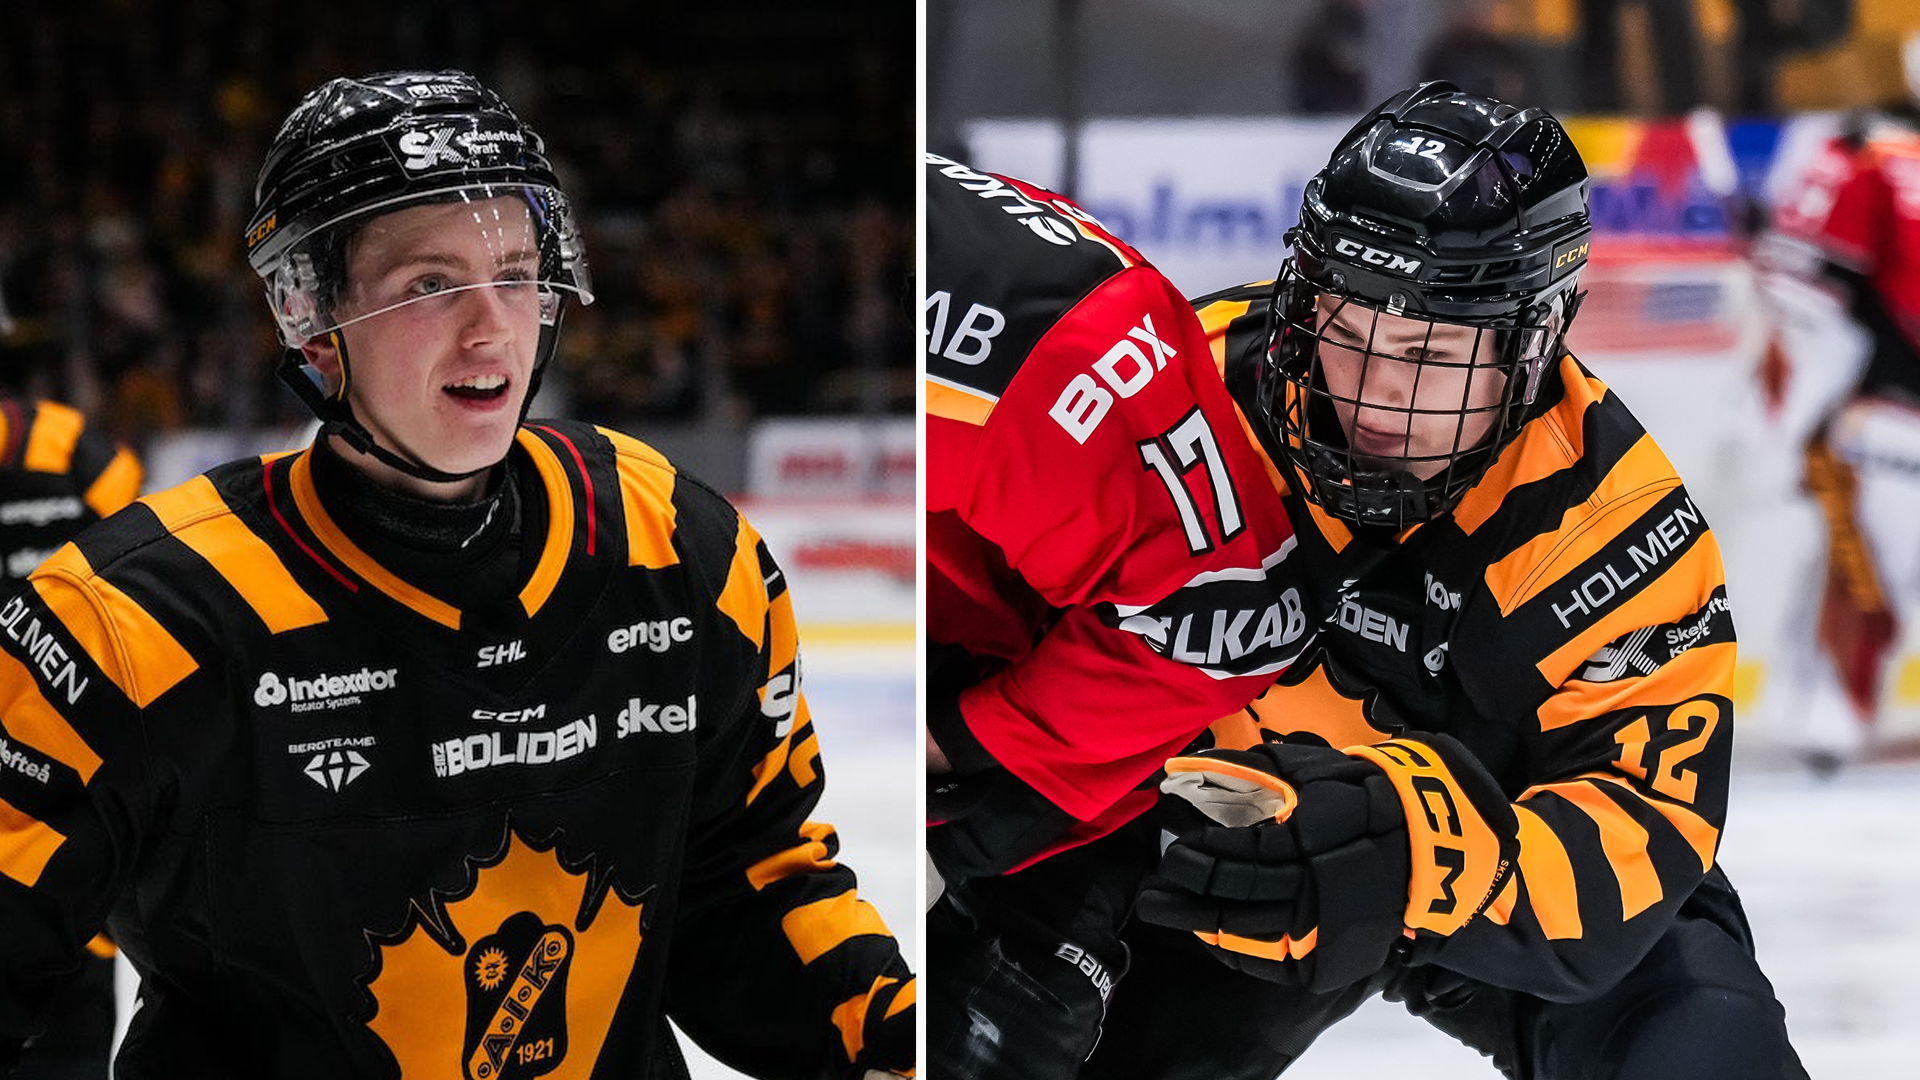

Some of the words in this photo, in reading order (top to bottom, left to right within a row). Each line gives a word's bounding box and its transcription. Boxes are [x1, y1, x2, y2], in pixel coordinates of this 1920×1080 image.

[1403, 136, 1446, 160] 12
[248, 214, 277, 248] CCM
[1334, 237, 1422, 274] CCM
[1555, 242, 1590, 269] CCM
[1048, 312, 1178, 445] BDX
[1136, 404, 1247, 557] 17
[1551, 498, 1700, 629] HOLMEN
[1172, 587, 1307, 665] LKAB
[0, 596, 89, 705] OLMEN
[477, 639, 527, 668] SHL
[291, 700, 325, 713] Rotator
[472, 704, 546, 722] CCM
[0, 738, 51, 784] lefteå
[288, 736, 377, 754] BERGTEAME
[445, 714, 597, 777] BOLIDEN
[1611, 700, 1720, 804] 12
[516, 1037, 555, 1066] 1921
